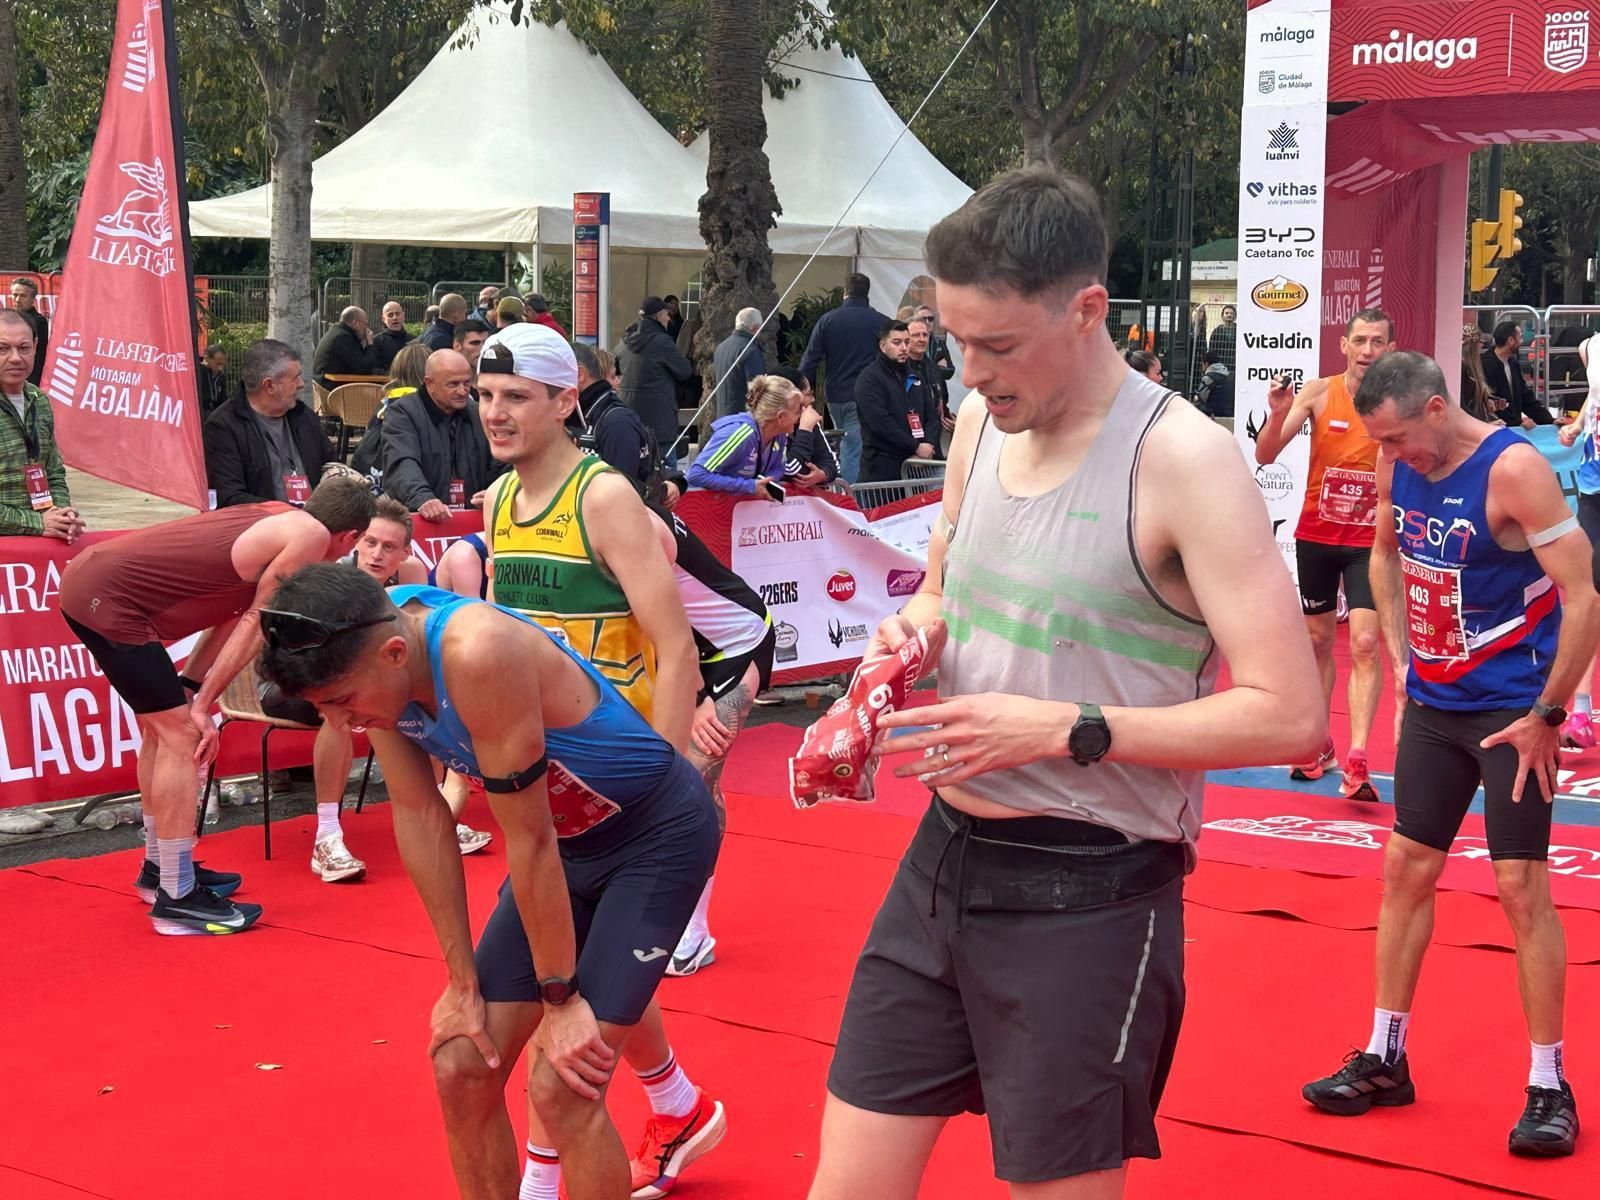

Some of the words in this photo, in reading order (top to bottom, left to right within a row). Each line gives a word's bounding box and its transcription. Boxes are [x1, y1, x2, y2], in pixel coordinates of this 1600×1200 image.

[1268, 182, 1317, 196] vithas
[1245, 227, 1315, 243] BYD
[1245, 249, 1292, 258] Caetano
[1295, 248, 1315, 257] Tec
[1323, 249, 1360, 268] ENERALI
[581, 262, 588, 274] 5
[1257, 290, 1301, 299] Gourmet
[1243, 332, 1312, 349] Vitaldin
[1339, 483, 1363, 496] 435
[759, 521, 824, 545] GENERALI
[760, 581, 798, 607] 226ERS
[829, 580, 854, 593] Juver
[1409, 584, 1429, 606] 403
